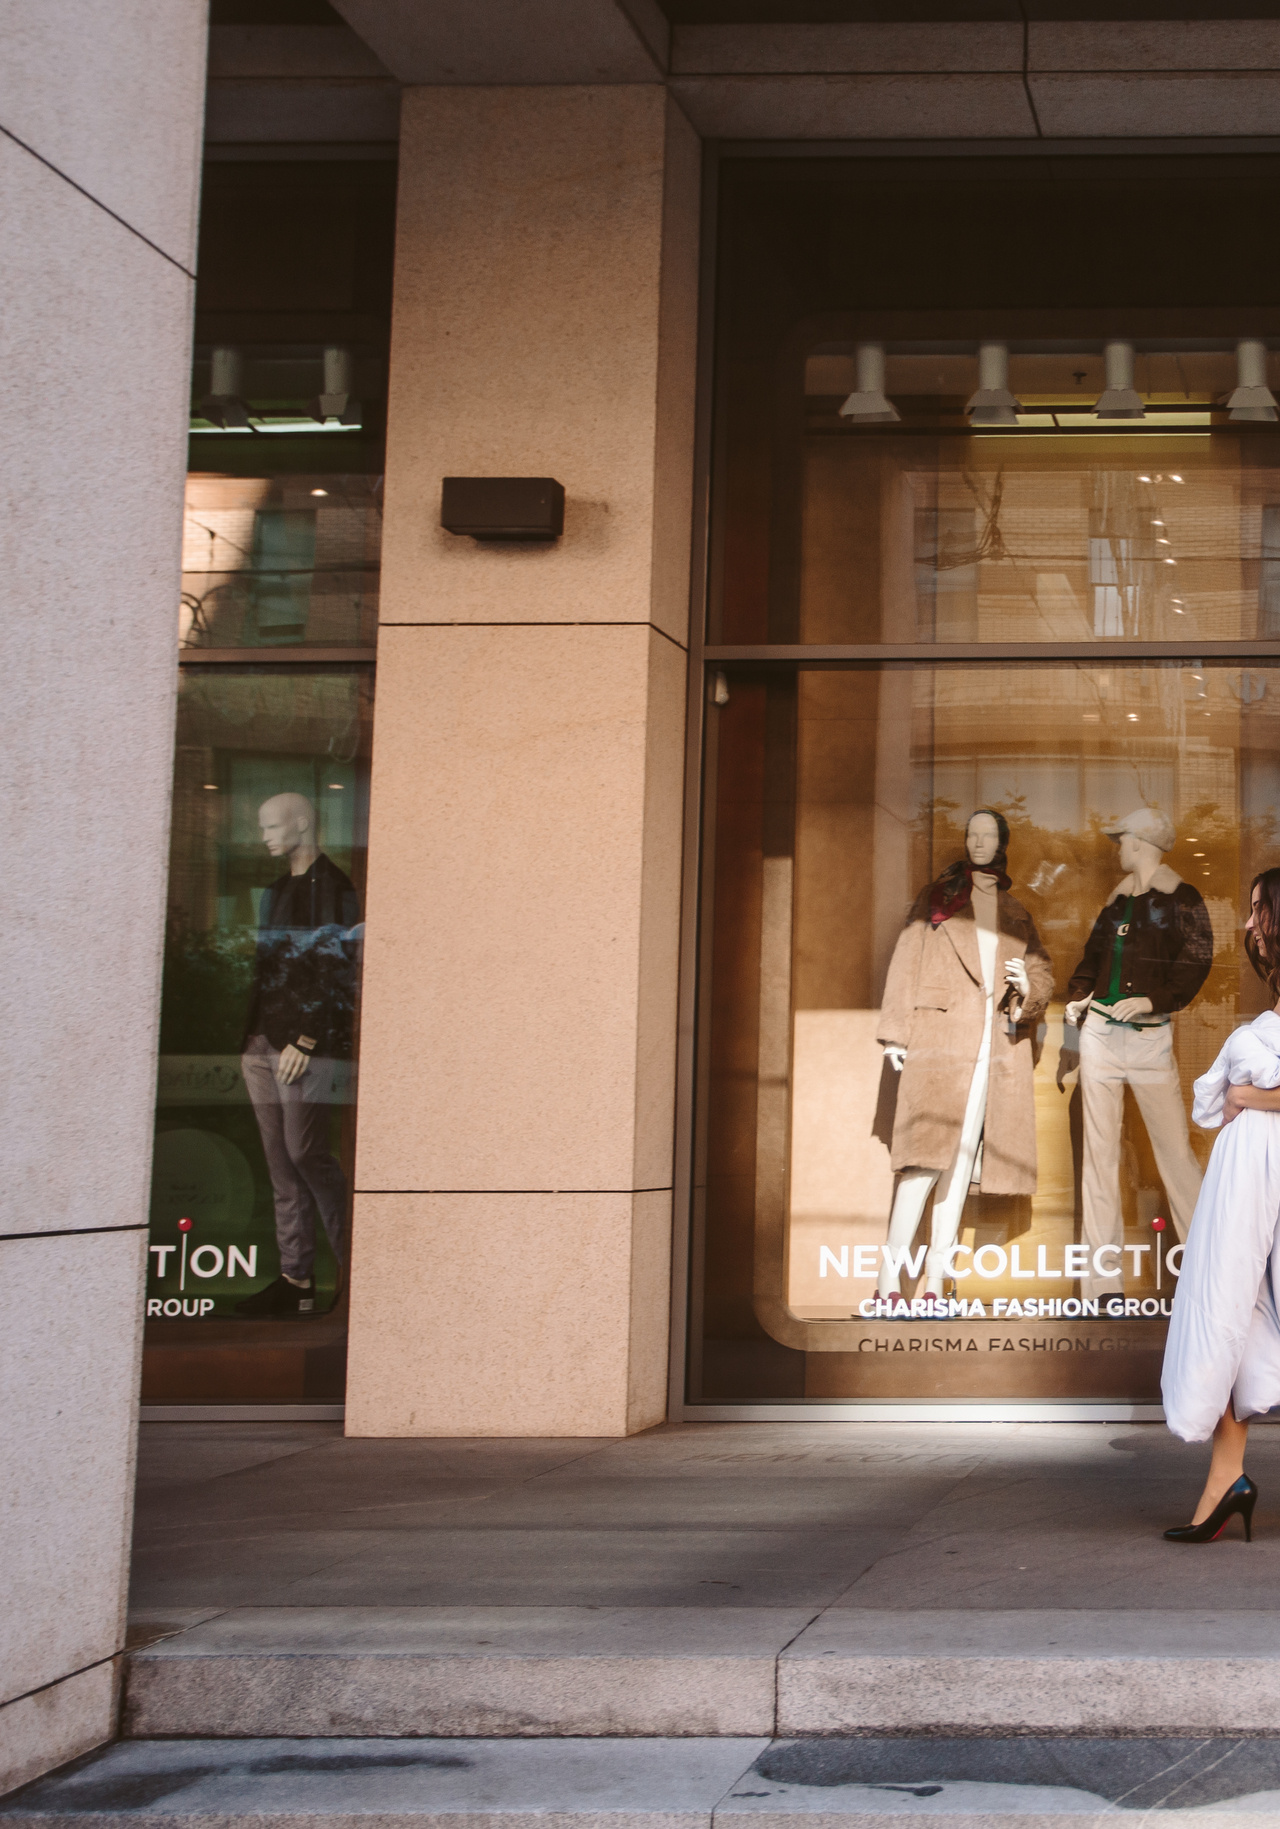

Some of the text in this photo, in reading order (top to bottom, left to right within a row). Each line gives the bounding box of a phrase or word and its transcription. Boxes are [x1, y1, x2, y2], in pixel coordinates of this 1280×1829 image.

[819, 1244, 927, 1278] NEW
[858, 1297, 986, 1317] CHARISMA
[993, 1297, 1099, 1317] FASHION
